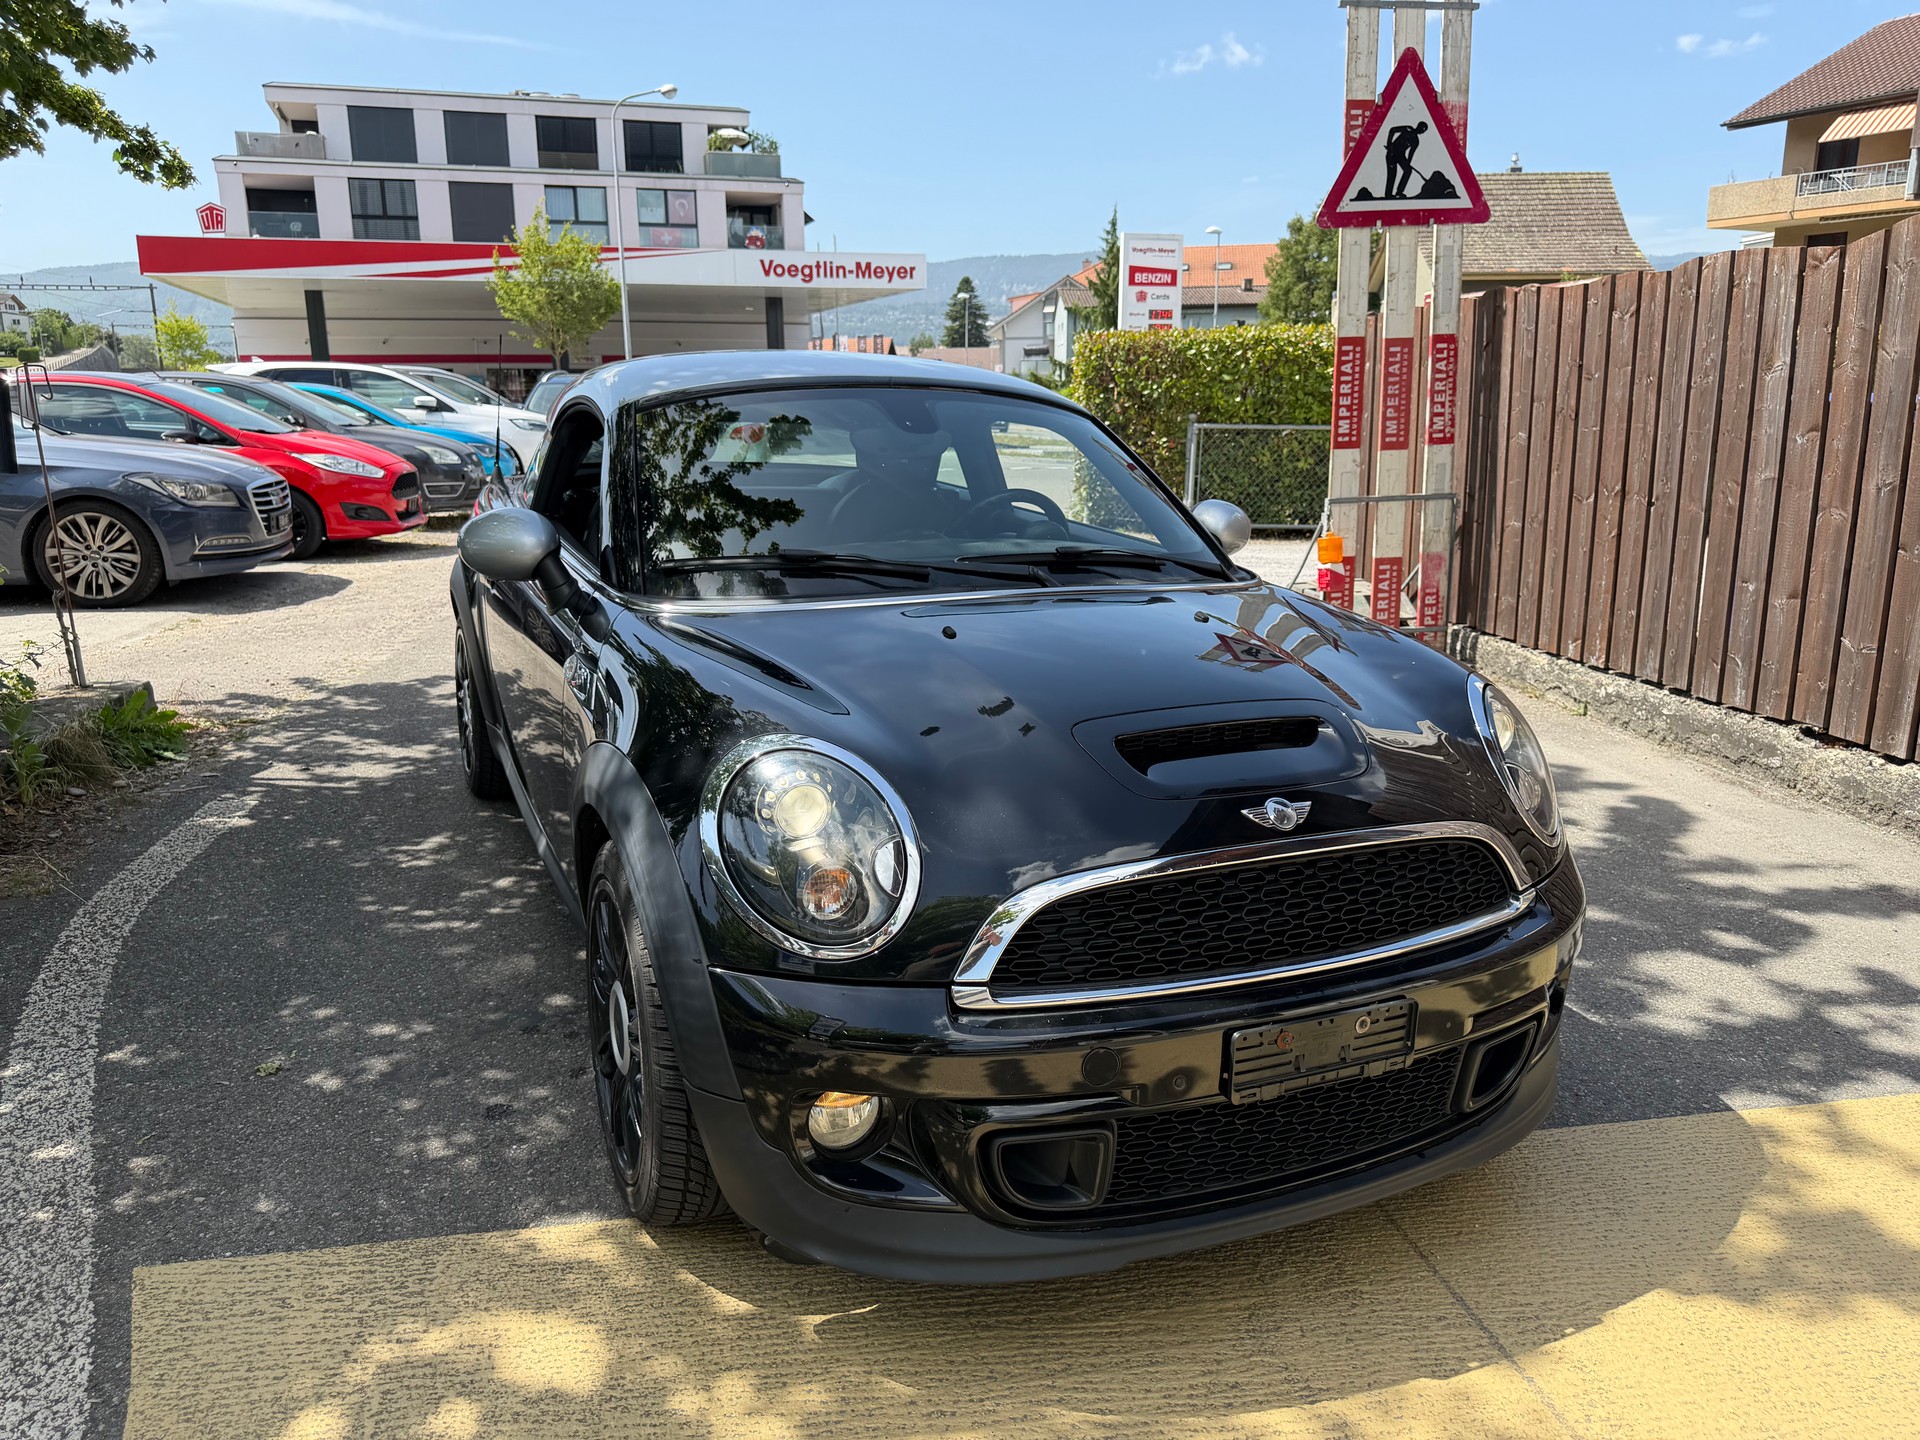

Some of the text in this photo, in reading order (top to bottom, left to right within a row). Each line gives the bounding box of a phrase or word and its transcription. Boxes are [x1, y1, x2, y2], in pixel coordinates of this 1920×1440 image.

[200, 206, 224, 230] UTA
[759, 259, 916, 283] Voegtlin-Meyer
[1134, 272, 1172, 284] BENZIN
[1337, 345, 1354, 442] IMPERIALI
[1350, 346, 1361, 441] BAUUNTERNEHMUNG
[1385, 346, 1401, 442] IMPERIALI
[1432, 343, 1448, 438] IMPERIALI
[1376, 564, 1391, 620] ERIALI
